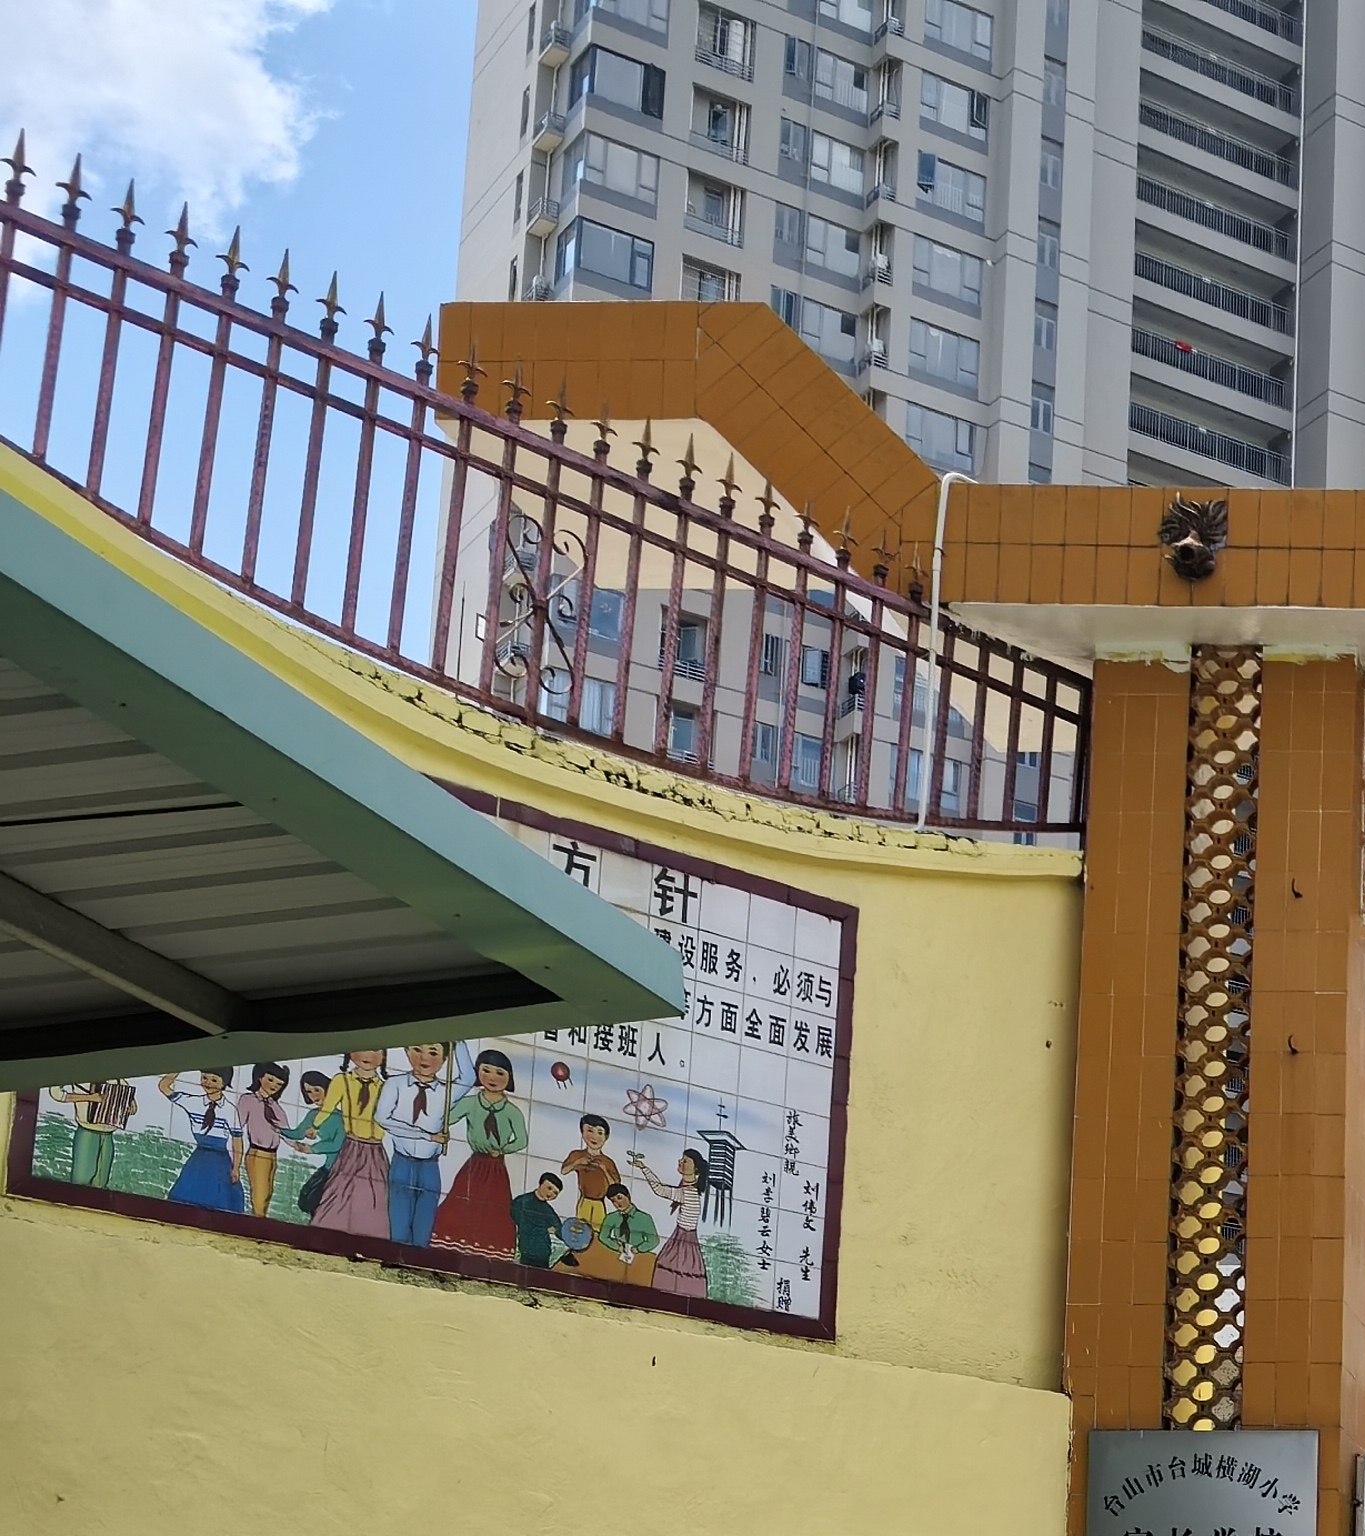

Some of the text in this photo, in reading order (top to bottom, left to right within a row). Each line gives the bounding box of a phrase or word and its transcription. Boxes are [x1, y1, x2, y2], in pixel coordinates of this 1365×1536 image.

[1103, 1453, 1301, 1517] 台山市台城横湖小学
